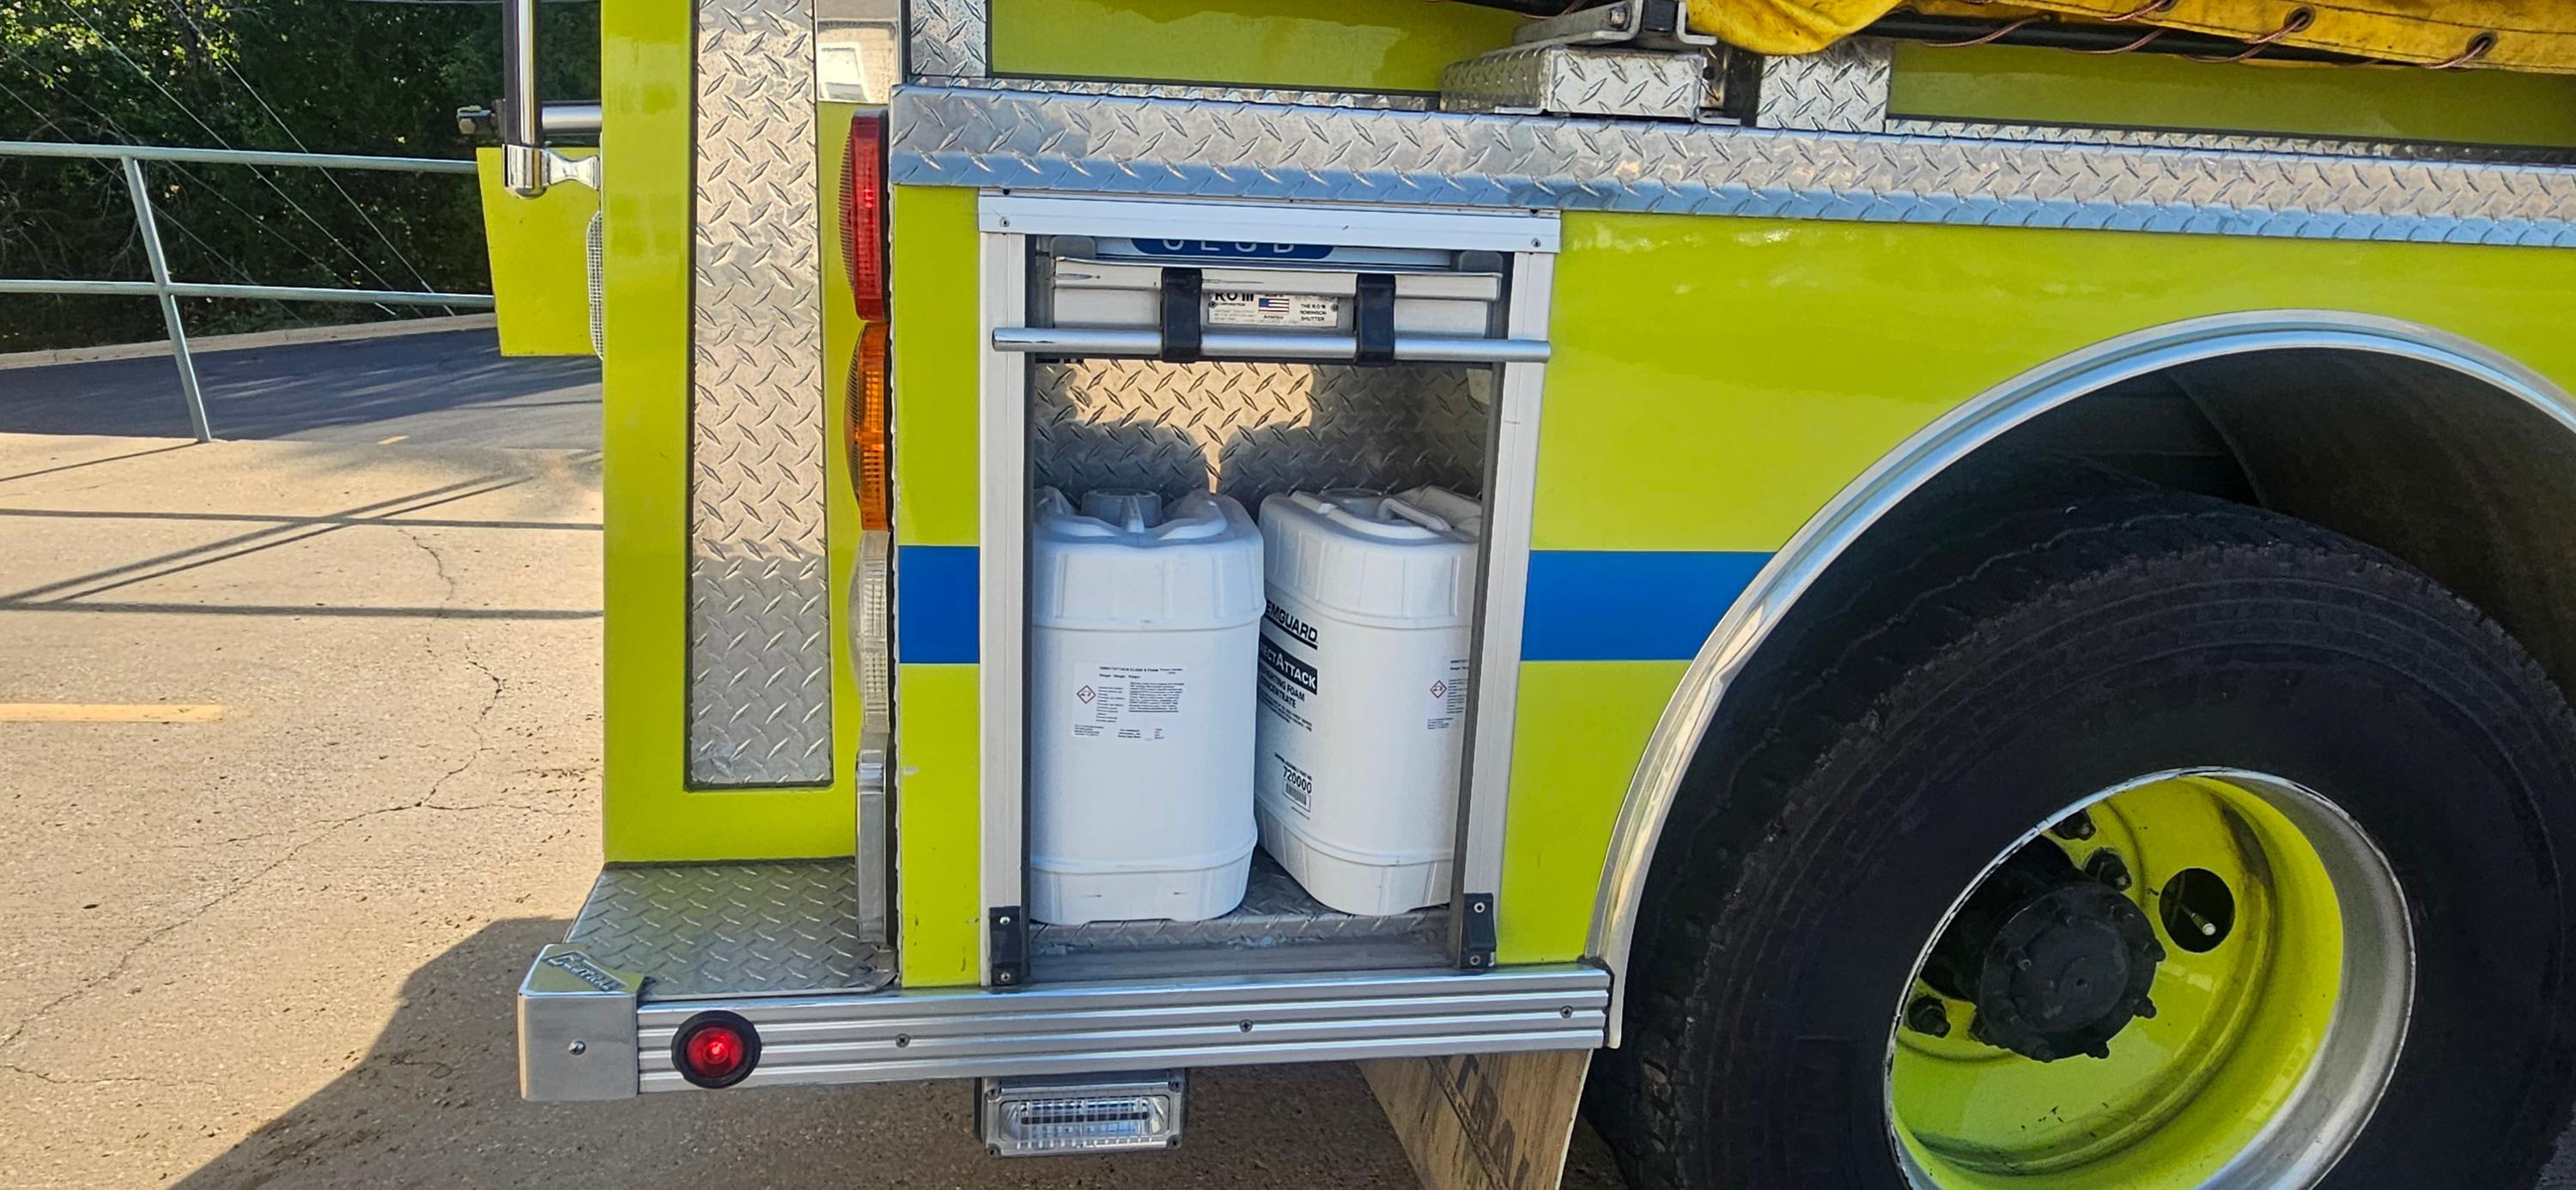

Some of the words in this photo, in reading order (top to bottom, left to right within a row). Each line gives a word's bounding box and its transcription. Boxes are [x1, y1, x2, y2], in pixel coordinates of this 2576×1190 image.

[1266, 599, 1318, 644] EMGUARD
[1287, 683, 1305, 702] FOAM
[1283, 765, 1313, 794] 720000
